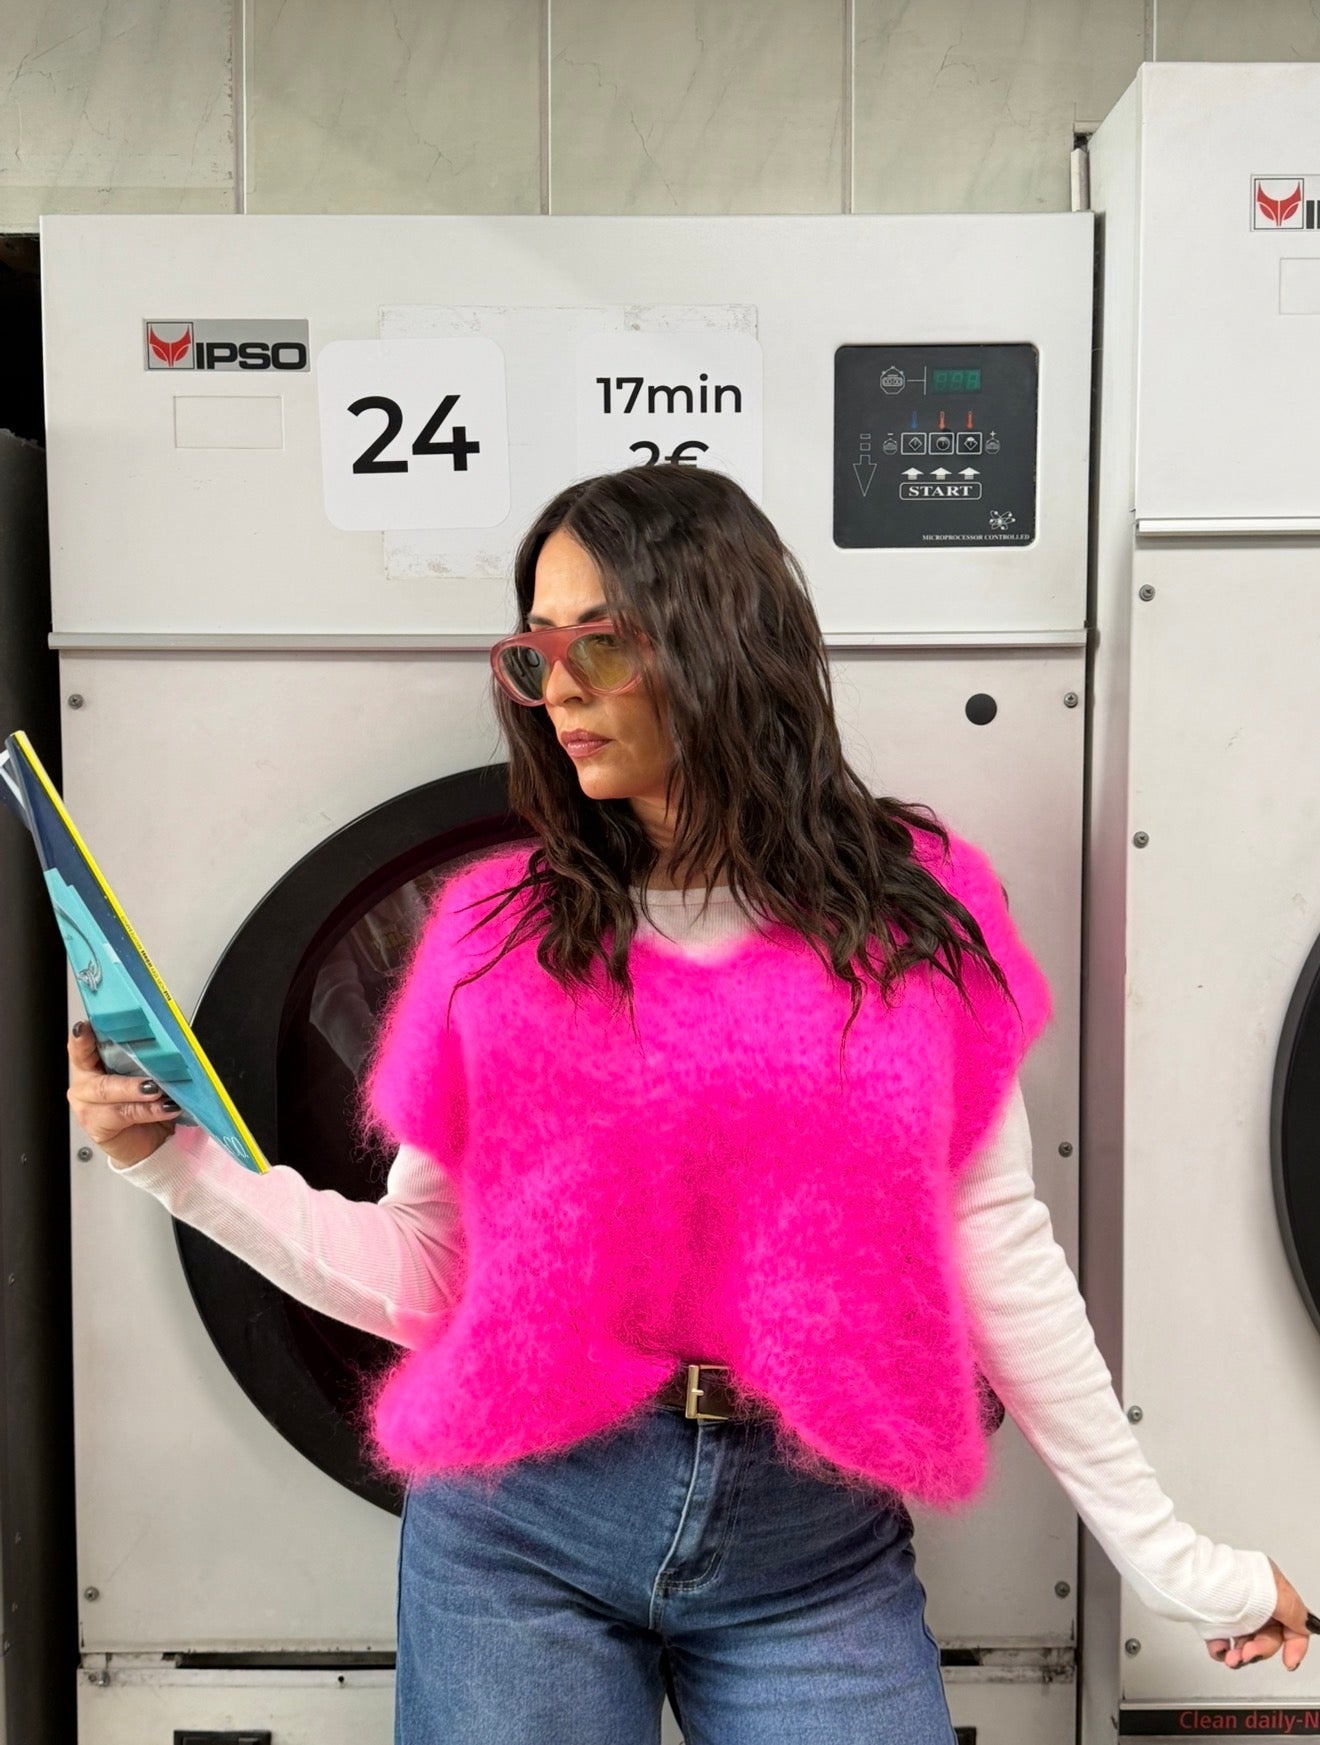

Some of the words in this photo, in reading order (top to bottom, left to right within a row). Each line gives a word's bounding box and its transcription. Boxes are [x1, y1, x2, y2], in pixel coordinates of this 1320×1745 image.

[196, 342, 307, 370] IPSO
[596, 373, 742, 414] 17min
[347, 395, 480, 474] 24
[629, 440, 709, 467] 2€
[908, 485, 973, 497] START
[1179, 1711, 1237, 1729] Clean
